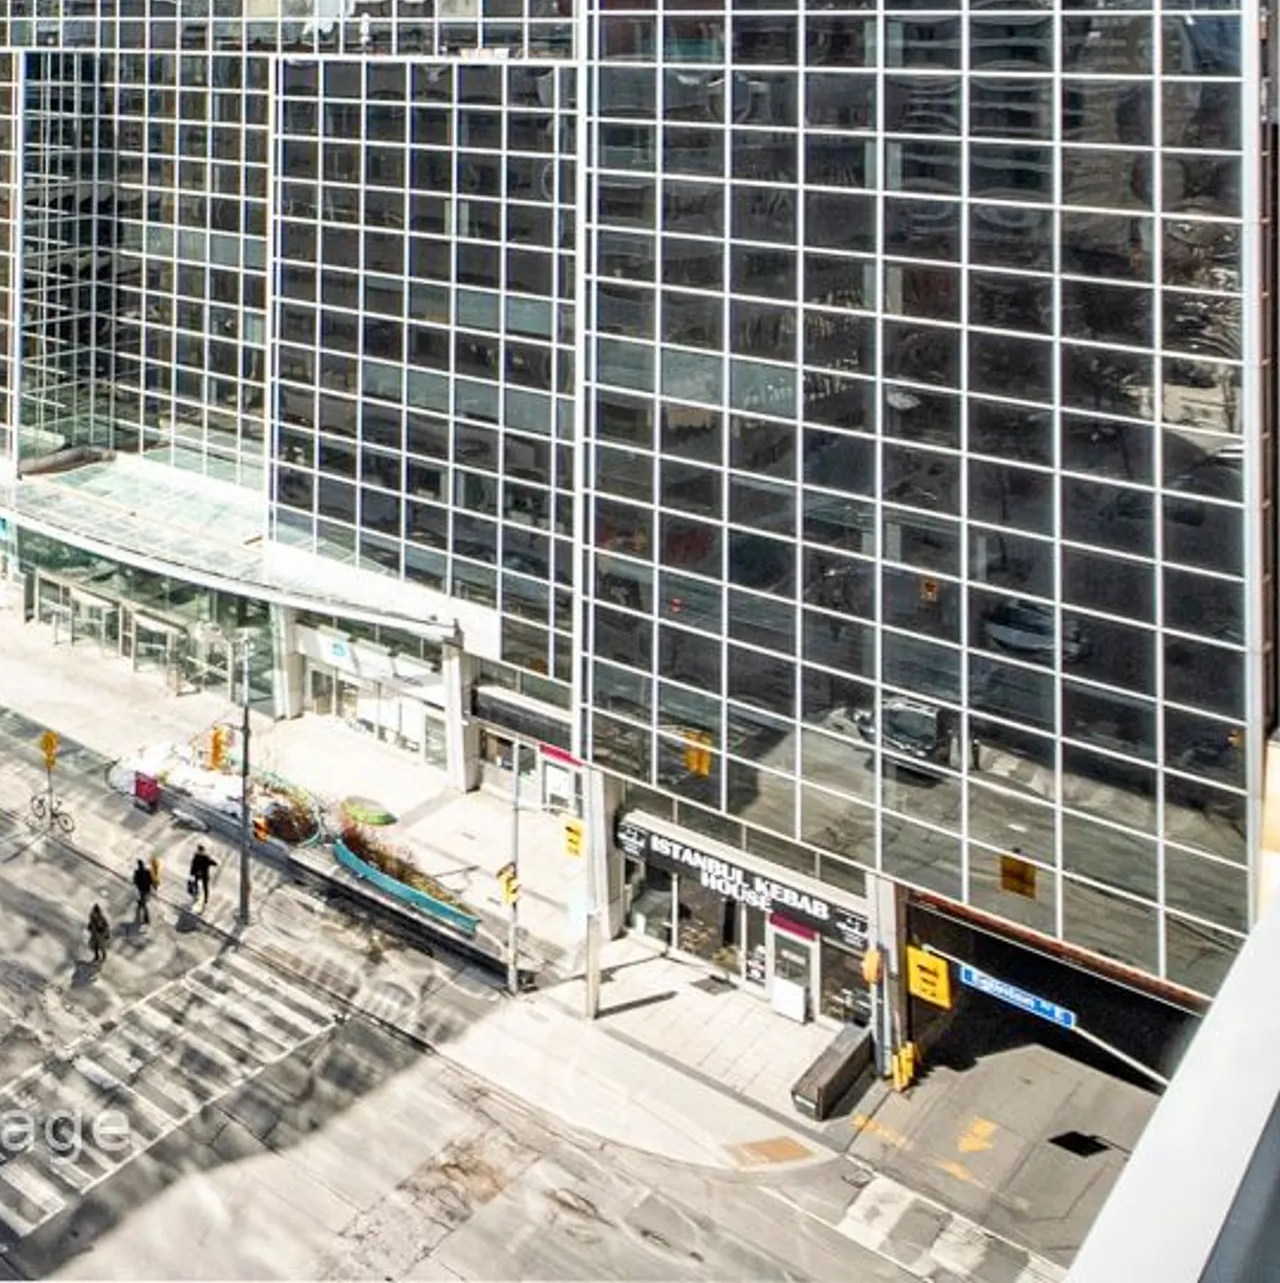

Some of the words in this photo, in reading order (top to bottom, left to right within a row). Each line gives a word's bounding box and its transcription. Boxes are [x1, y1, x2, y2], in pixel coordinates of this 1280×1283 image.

[651, 835, 749, 891] ISTANBUL
[753, 877, 830, 919] KEBAB
[700, 870, 774, 913] HOUSE
